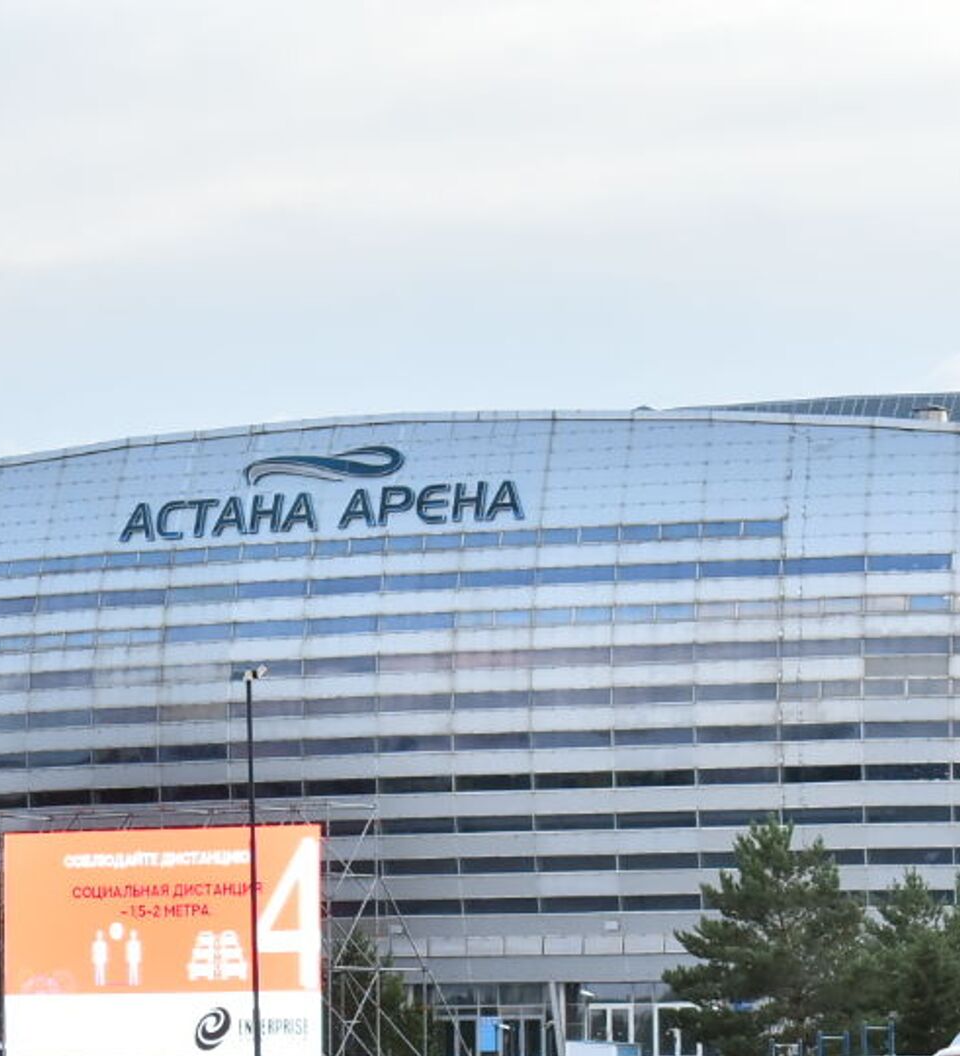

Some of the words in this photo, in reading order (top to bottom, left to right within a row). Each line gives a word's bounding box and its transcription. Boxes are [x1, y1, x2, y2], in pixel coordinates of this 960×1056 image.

[119, 492, 317, 542] АСТАНА
[339, 480, 525, 531] АРЕНА
[72, 883, 169, 899] СОЦИАЛЬНАЯ
[164, 903, 209, 918] МЕТРА
[256, 836, 320, 991] 4
[238, 1018, 309, 1037] ENERPRISE
